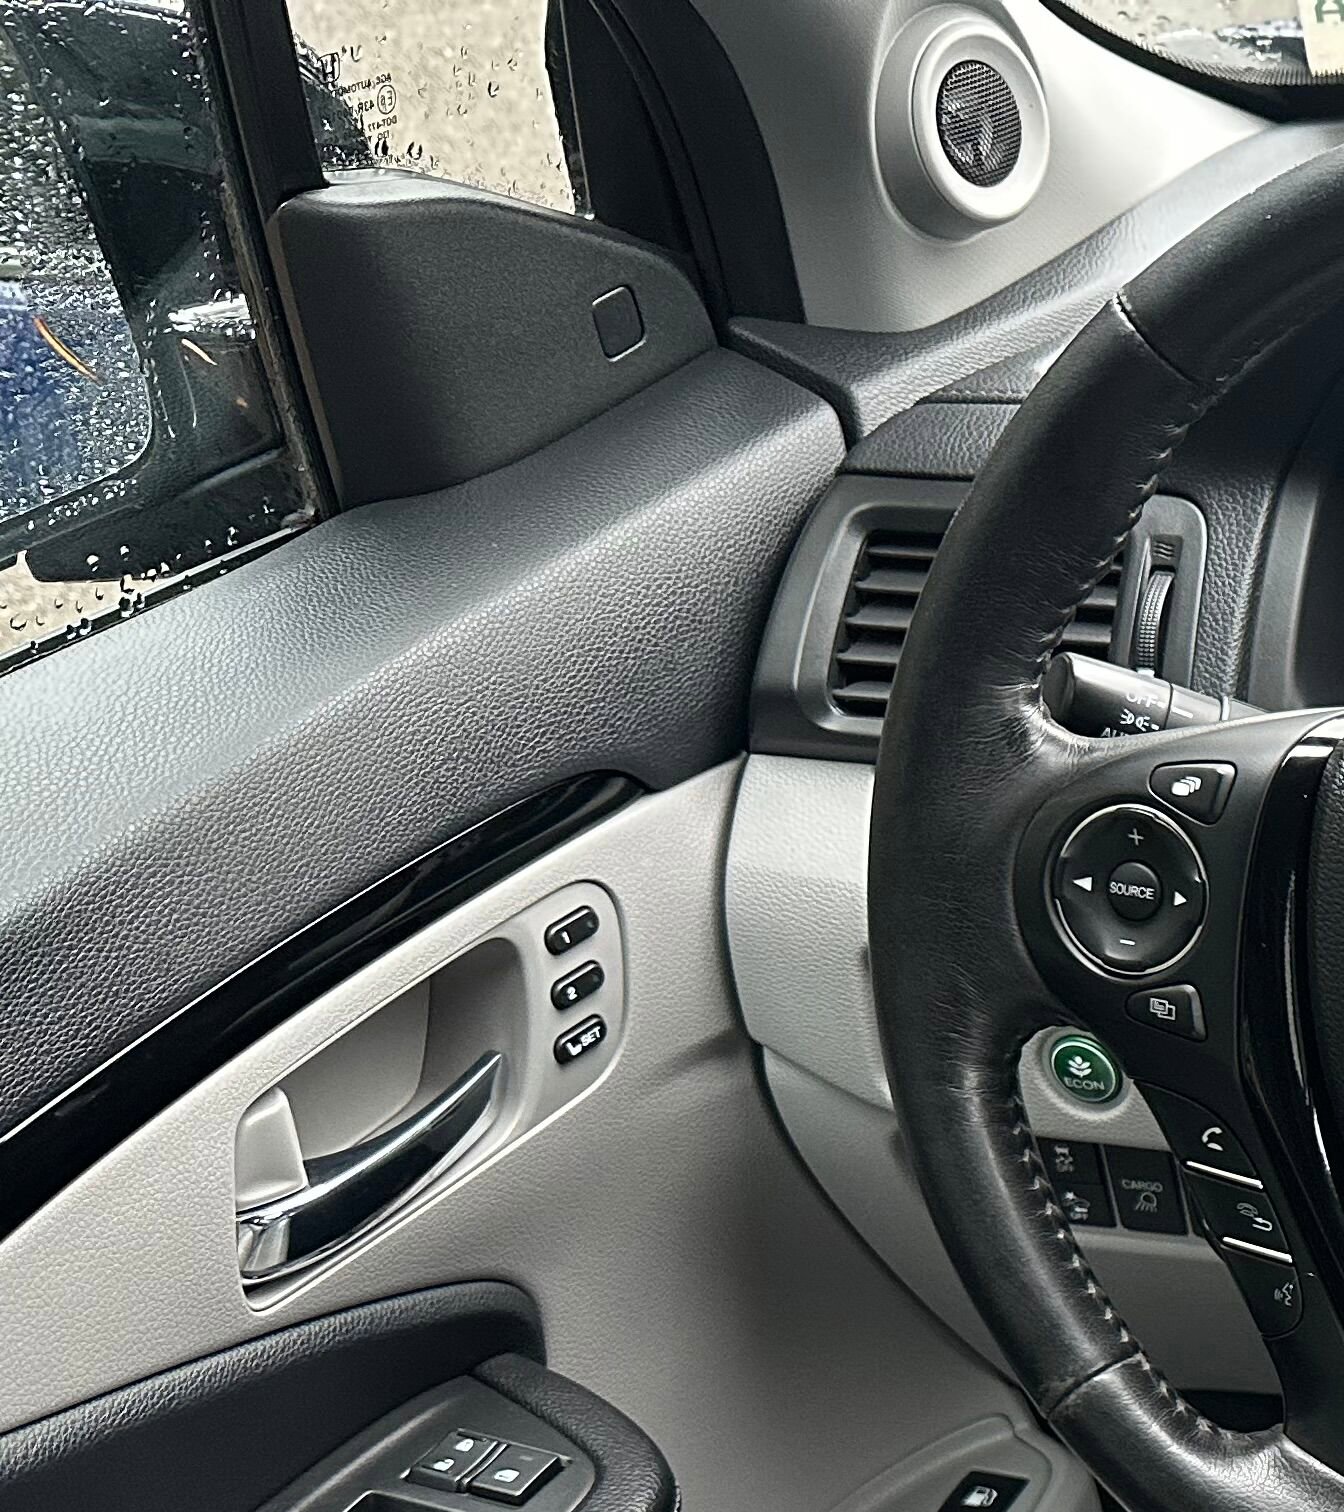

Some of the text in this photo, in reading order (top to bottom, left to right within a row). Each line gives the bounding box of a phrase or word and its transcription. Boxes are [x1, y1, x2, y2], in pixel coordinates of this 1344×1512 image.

[1109, 881, 1155, 900] SOURCE
[580, 1026, 601, 1046] SET
[1064, 1077, 1105, 1091] ECON
[1121, 1179, 1163, 1193] CARGO
